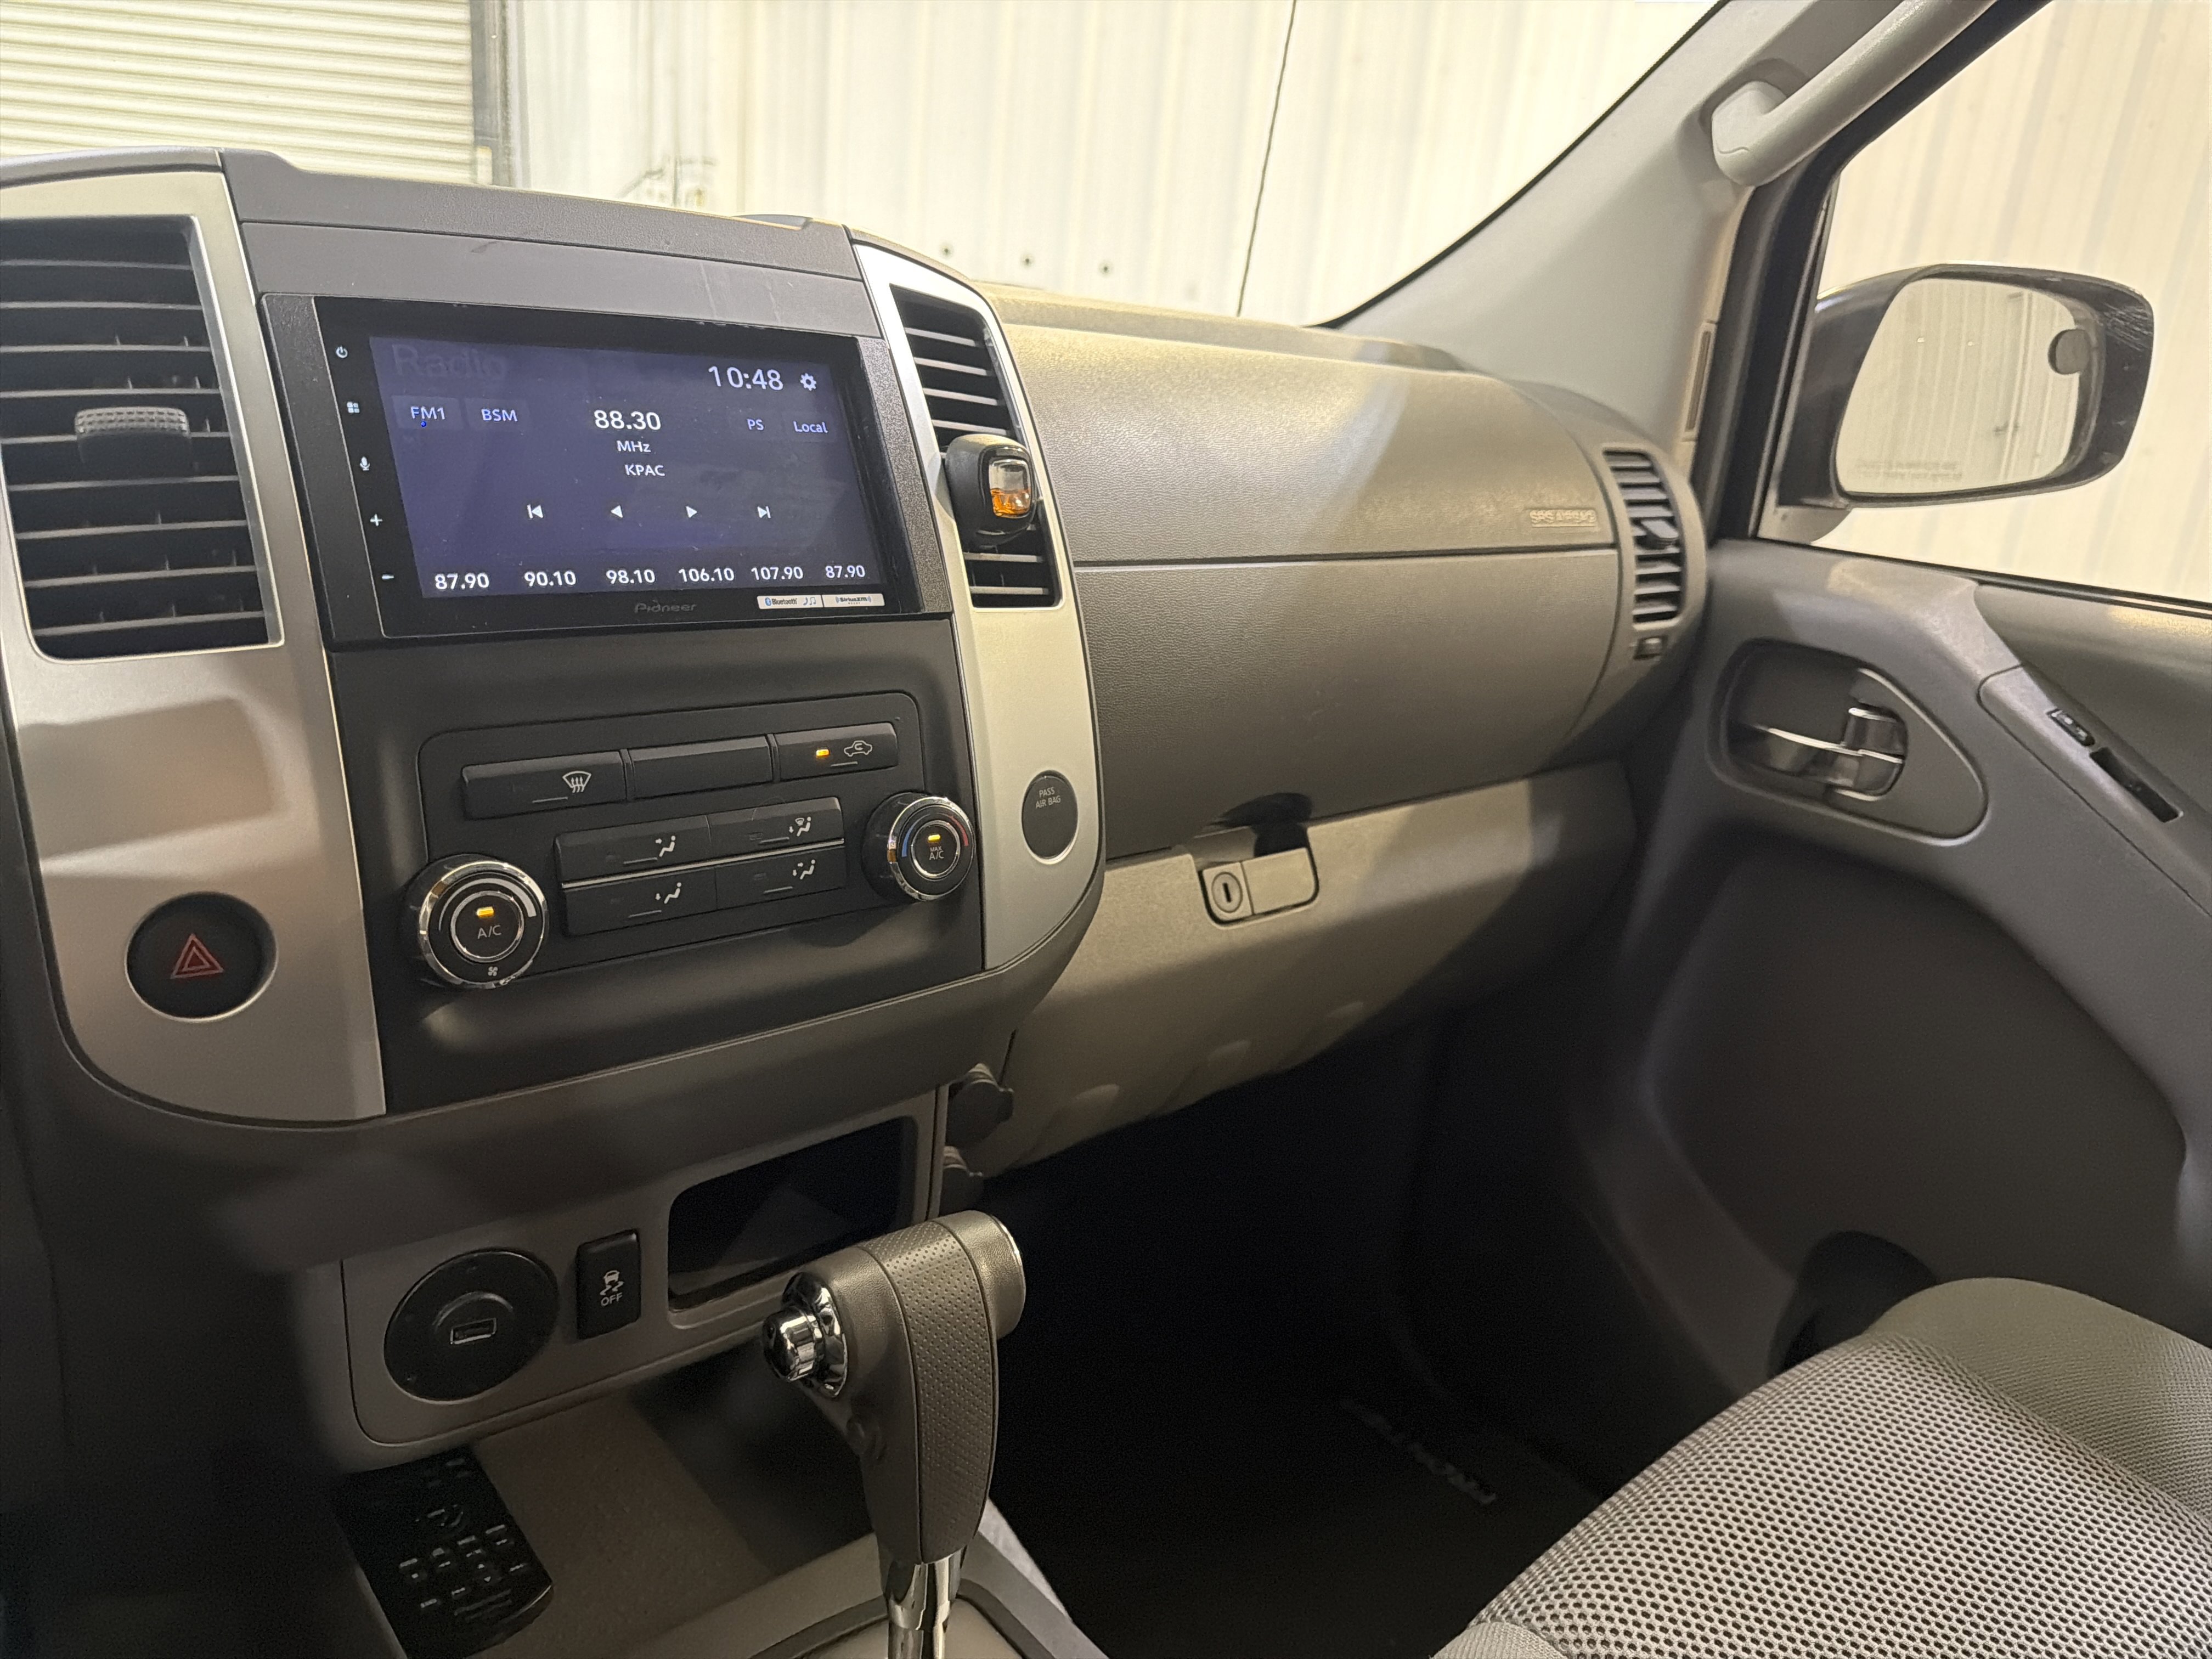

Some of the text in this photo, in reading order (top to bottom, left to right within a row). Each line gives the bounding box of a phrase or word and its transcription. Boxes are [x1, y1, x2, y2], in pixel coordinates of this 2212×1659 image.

[708, 366, 783, 391] 10:48
[410, 407, 445, 420] FM1
[482, 409, 517, 422] BSM
[595, 410, 661, 430] 88.30
[747, 418, 764, 431] PS
[793, 421, 827, 433] Local
[617, 441, 651, 453] MHz
[625, 464, 665, 476] KPAC
[607, 569, 655, 584] 98.10
[679, 567, 734, 583] 106.10
[751, 566, 803, 580] 107.90
[826, 565, 865, 578] 87.90
[435, 573, 489, 589] 87.90
[524, 571, 576, 586] 90.10
[1039, 787, 1054, 797] PASS
[1035, 795, 1060, 808] AIR BAG
[929, 851, 944, 860] A/C
[477, 925, 501, 939] A/C
[601, 1293, 623, 1307] OFF
